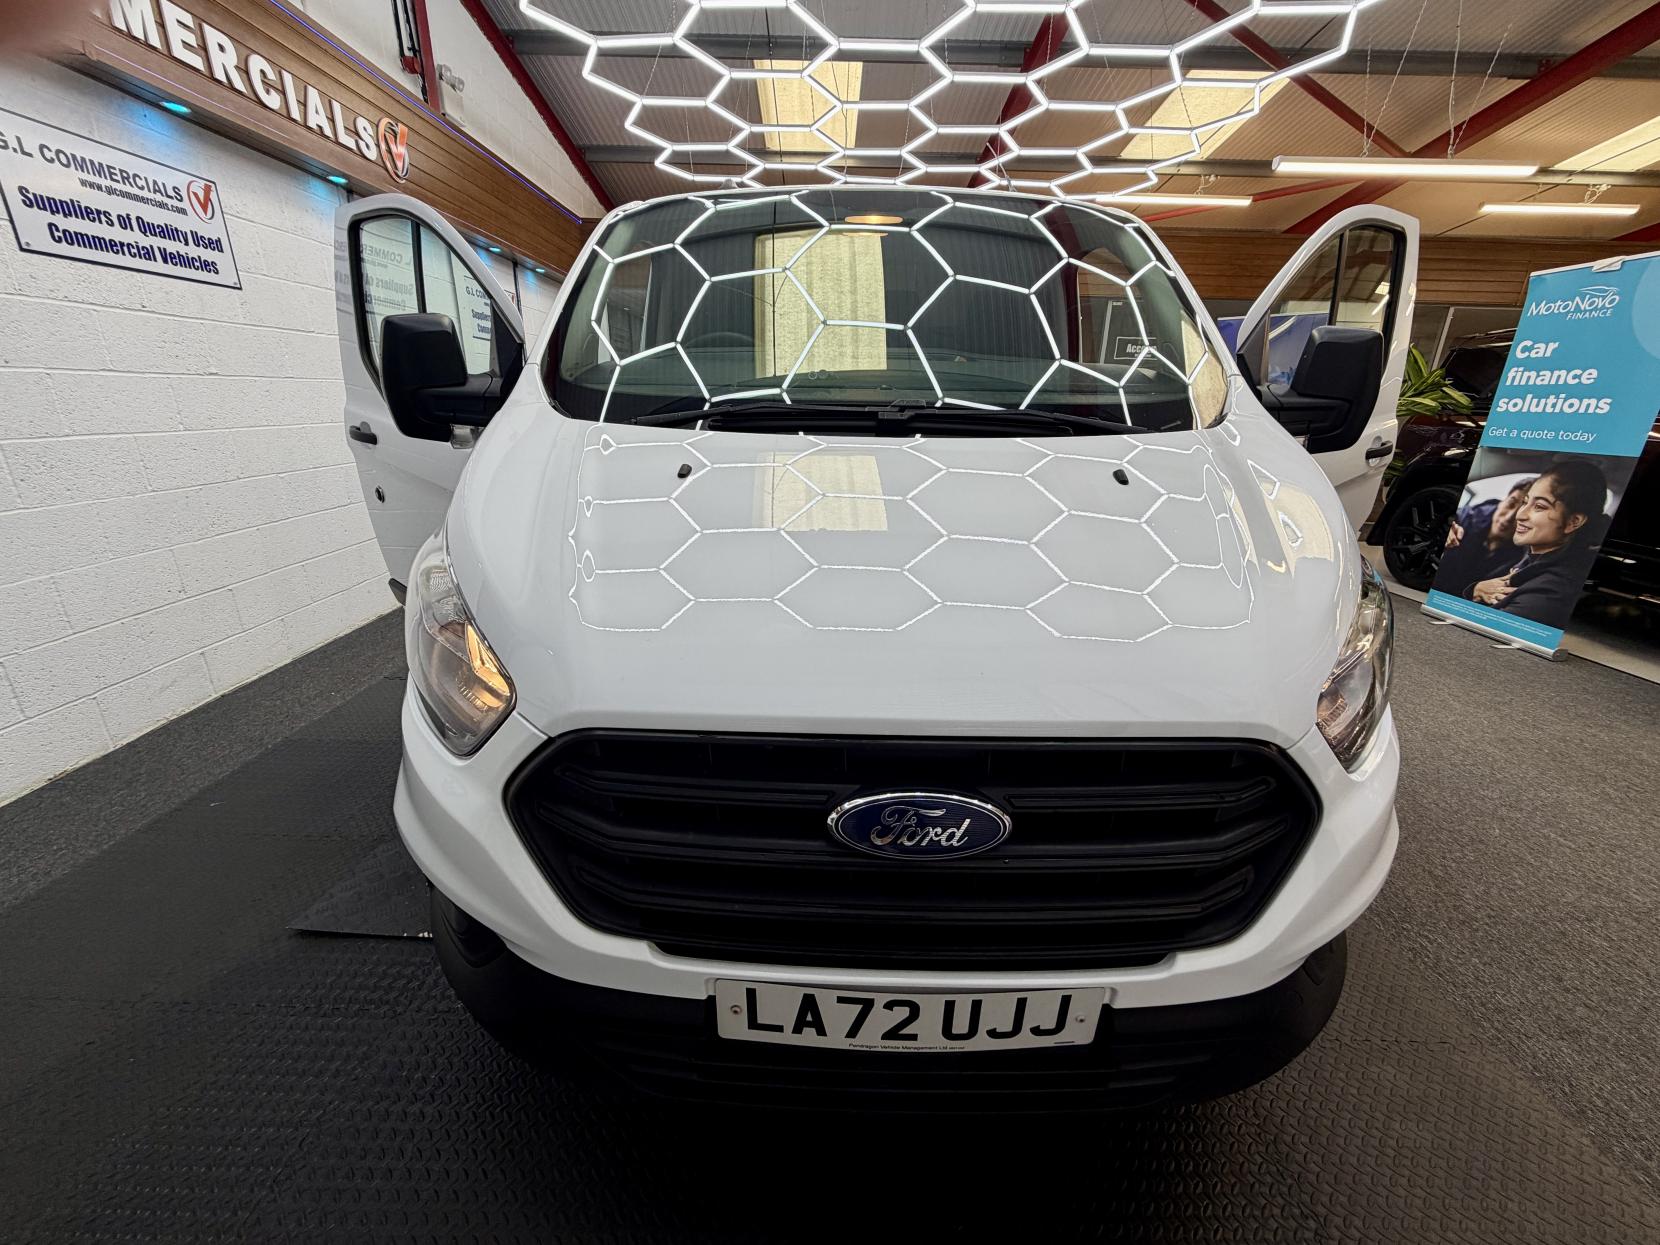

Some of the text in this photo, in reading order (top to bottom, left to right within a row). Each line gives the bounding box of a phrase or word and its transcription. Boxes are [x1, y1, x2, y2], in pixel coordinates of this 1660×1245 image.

[90, 0, 378, 162] MERCIALS
[38, 143, 184, 203] COMMERCIALS
[78, 177, 189, 217] www.glcommercials.com
[17, 185, 225, 254] Suppliers of Quality Used
[47, 222, 220, 276] Commercial Vehicles
[1527, 290, 1620, 317] MotoNovo
[1566, 309, 1613, 320] FINANCE
[1515, 340, 1560, 359] Car
[1505, 366, 1598, 386] finance
[1496, 394, 1613, 414] solutions
[1488, 426, 1597, 443] Get a quote today
[870, 805, 971, 847] Ford
[745, 987, 1073, 1042] LA72 UJJ
